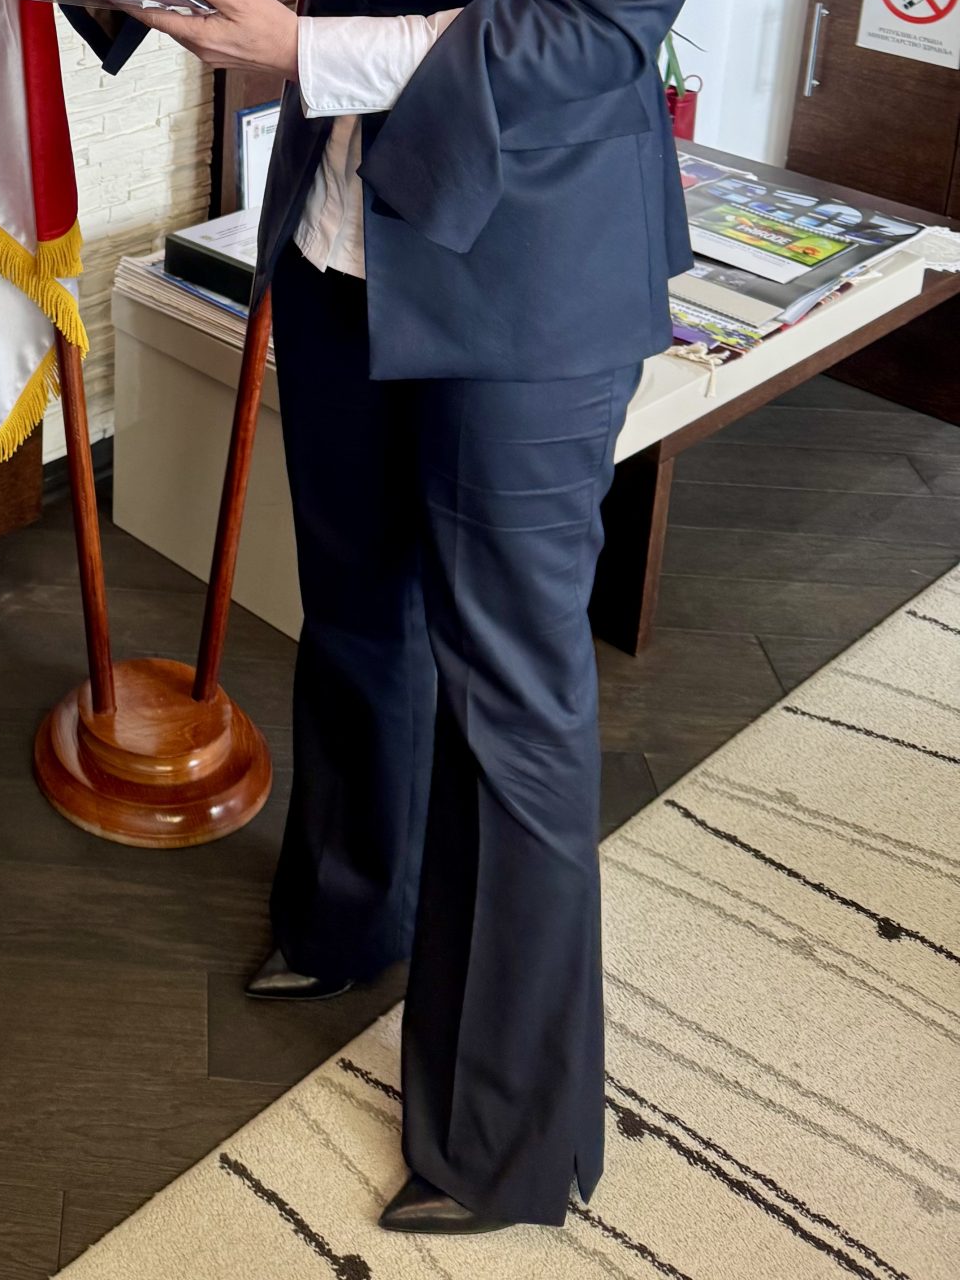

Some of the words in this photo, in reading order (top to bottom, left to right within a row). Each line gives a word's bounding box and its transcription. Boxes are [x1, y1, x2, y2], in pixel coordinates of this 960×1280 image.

[867, 31, 922, 49] МИНИСТАРСТВО
[923, 43, 953, 56] ЗДРАВЉА
[878, 26, 919, 41] РЕПУБЛИКА
[919, 34, 943, 46] СРБИЈА
